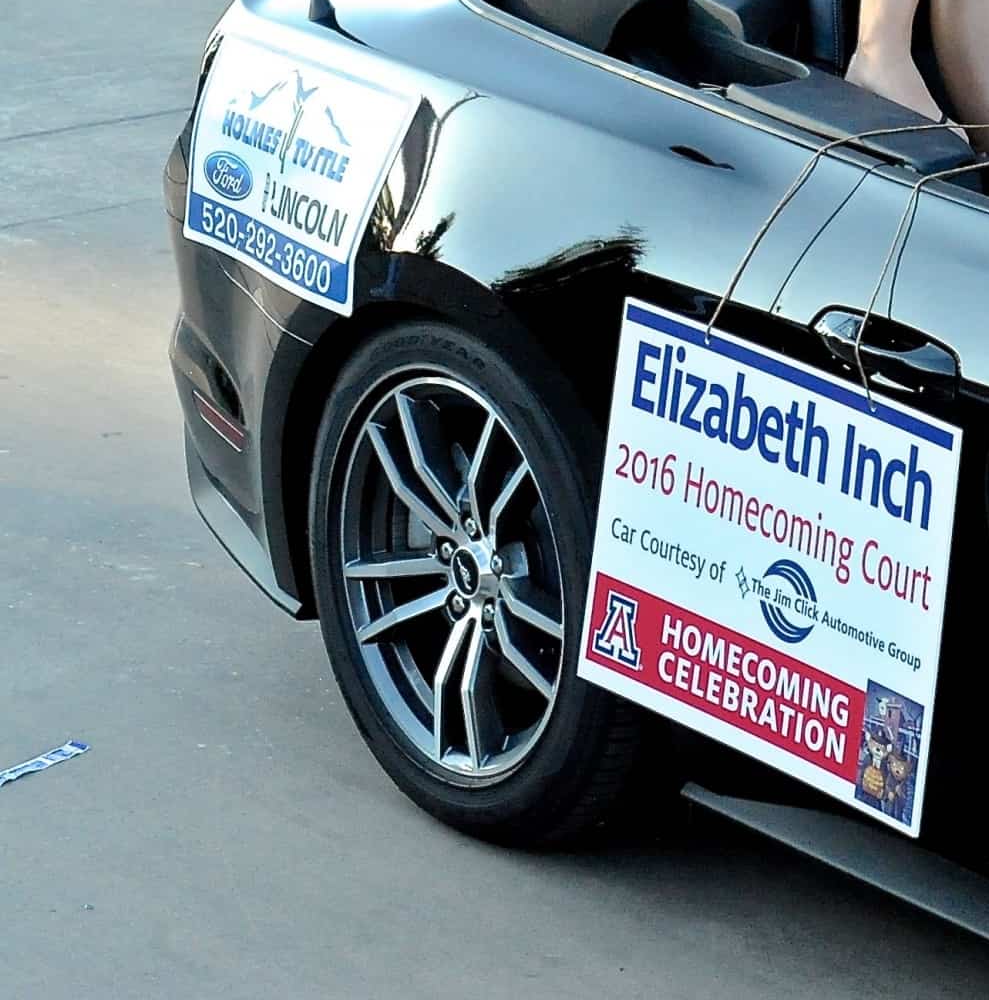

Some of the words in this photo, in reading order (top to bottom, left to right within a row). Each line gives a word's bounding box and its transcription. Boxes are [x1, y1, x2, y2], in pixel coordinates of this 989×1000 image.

[211, 157, 244, 194] Ford
[222, 110, 284, 156] HOLMES
[291, 138, 350, 184] TUTTLE
[201, 202, 331, 295] 520-292-3600
[269, 180, 349, 248] LINCOLN
[631, 340, 830, 485] Elizabeth
[840, 424, 933, 531] Inch
[611, 517, 637, 544] Car
[640, 529, 706, 579] Courtesy
[709, 560, 727, 584] of
[615, 443, 677, 495] 2016
[683, 461, 854, 584] Homecoming
[861, 540, 932, 611] Court
[592, 590, 640, 671] A
[661, 613, 849, 728] HOMECOMING
[751, 578, 771, 600] The
[773, 588, 791, 610] Jim
[794, 597, 820, 622] Click
[821, 610, 886, 653] Automotive
[887, 641, 922, 672] Group
[657, 652, 846, 765] CELEBRATION
